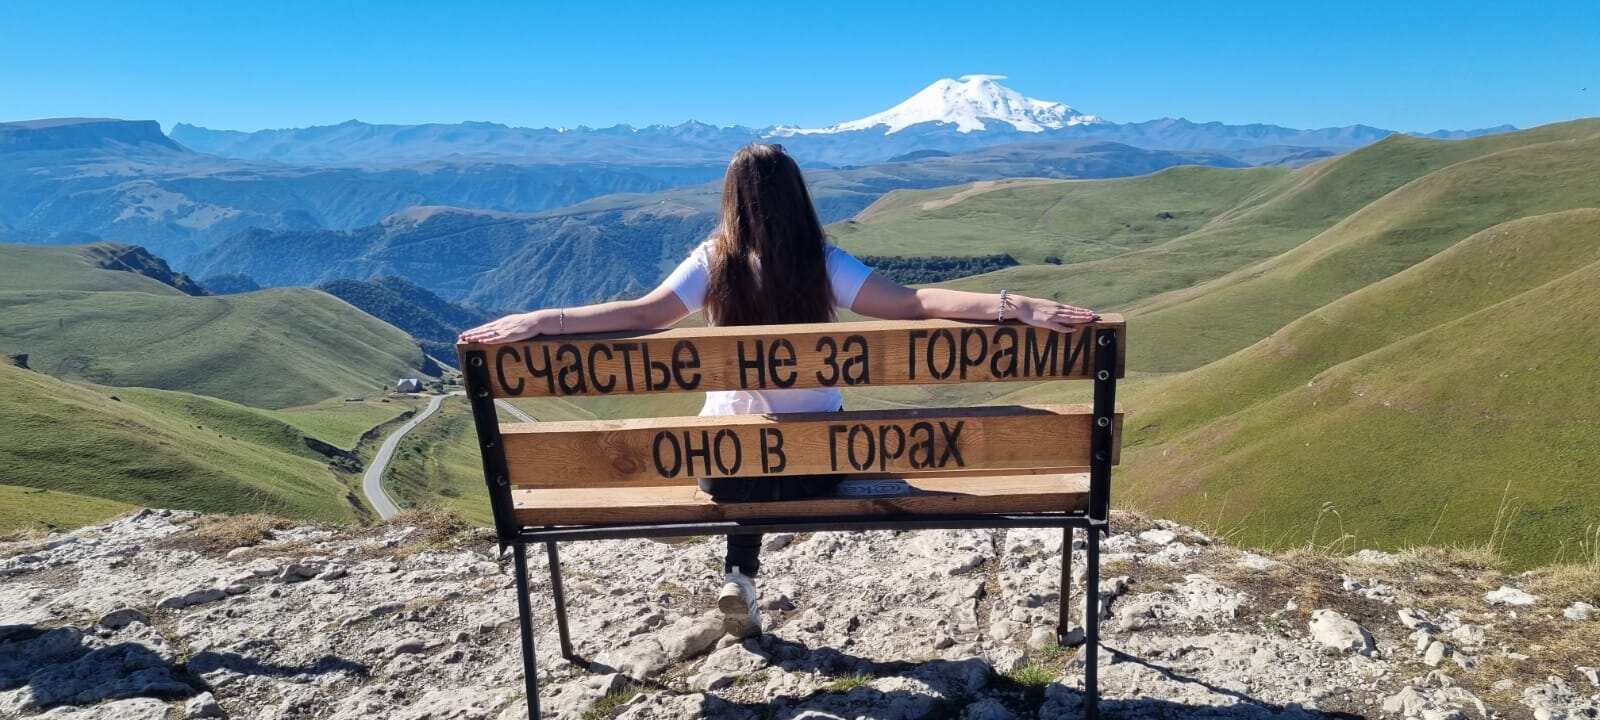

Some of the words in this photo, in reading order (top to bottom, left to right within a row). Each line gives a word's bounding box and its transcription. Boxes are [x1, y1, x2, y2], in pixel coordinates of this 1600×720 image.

[737, 339, 798, 389] не
[815, 335, 871, 385] за
[829, 421, 966, 472] горах
